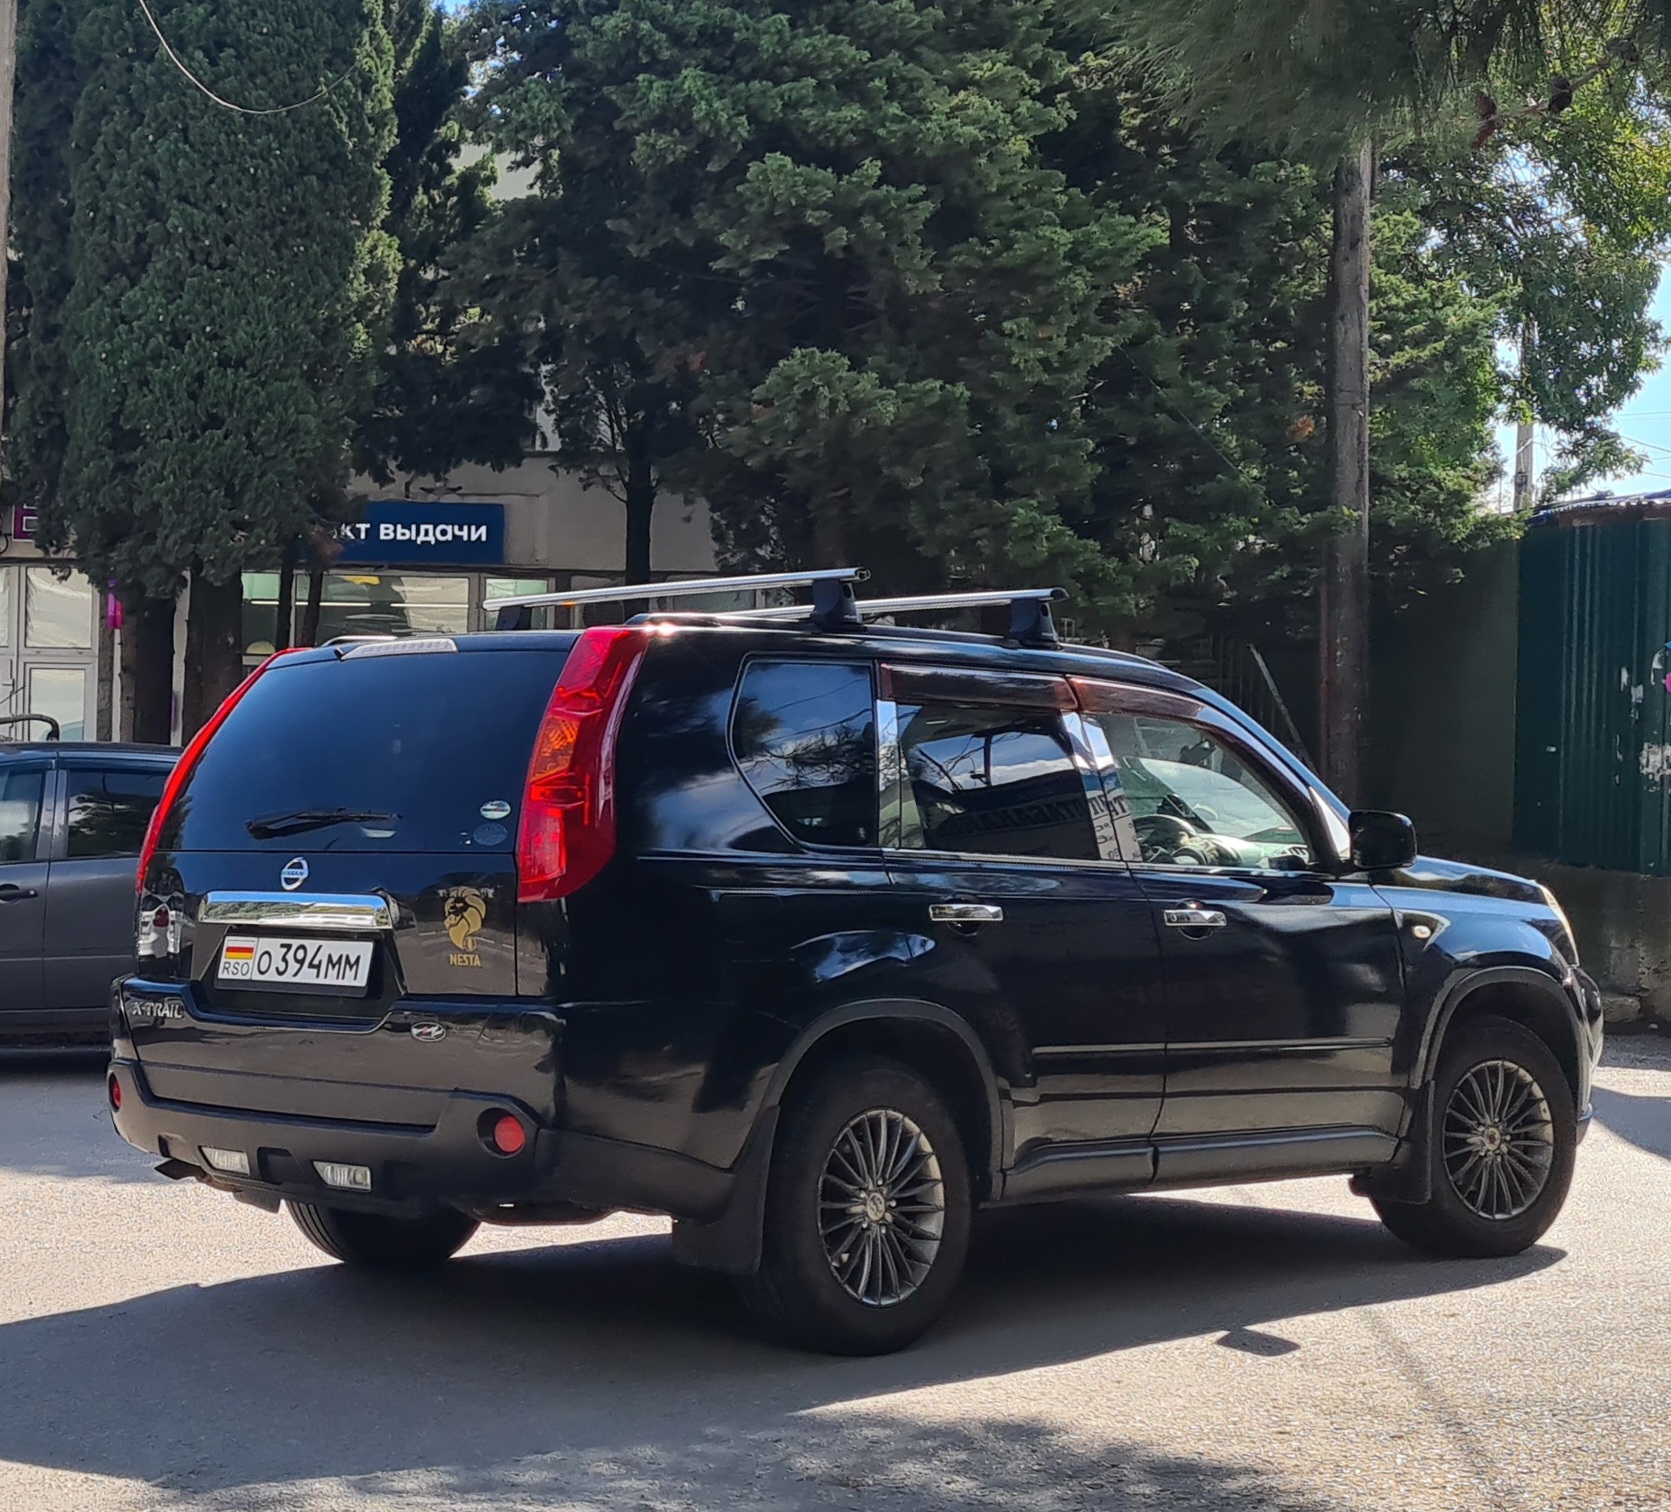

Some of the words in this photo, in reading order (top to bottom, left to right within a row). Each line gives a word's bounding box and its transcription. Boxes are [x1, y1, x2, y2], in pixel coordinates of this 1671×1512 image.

[379, 523, 488, 545] выдачи
[449, 953, 482, 967] NESTA
[221, 961, 250, 977] RSO
[131, 1001, 183, 1019] X-TRAIL
